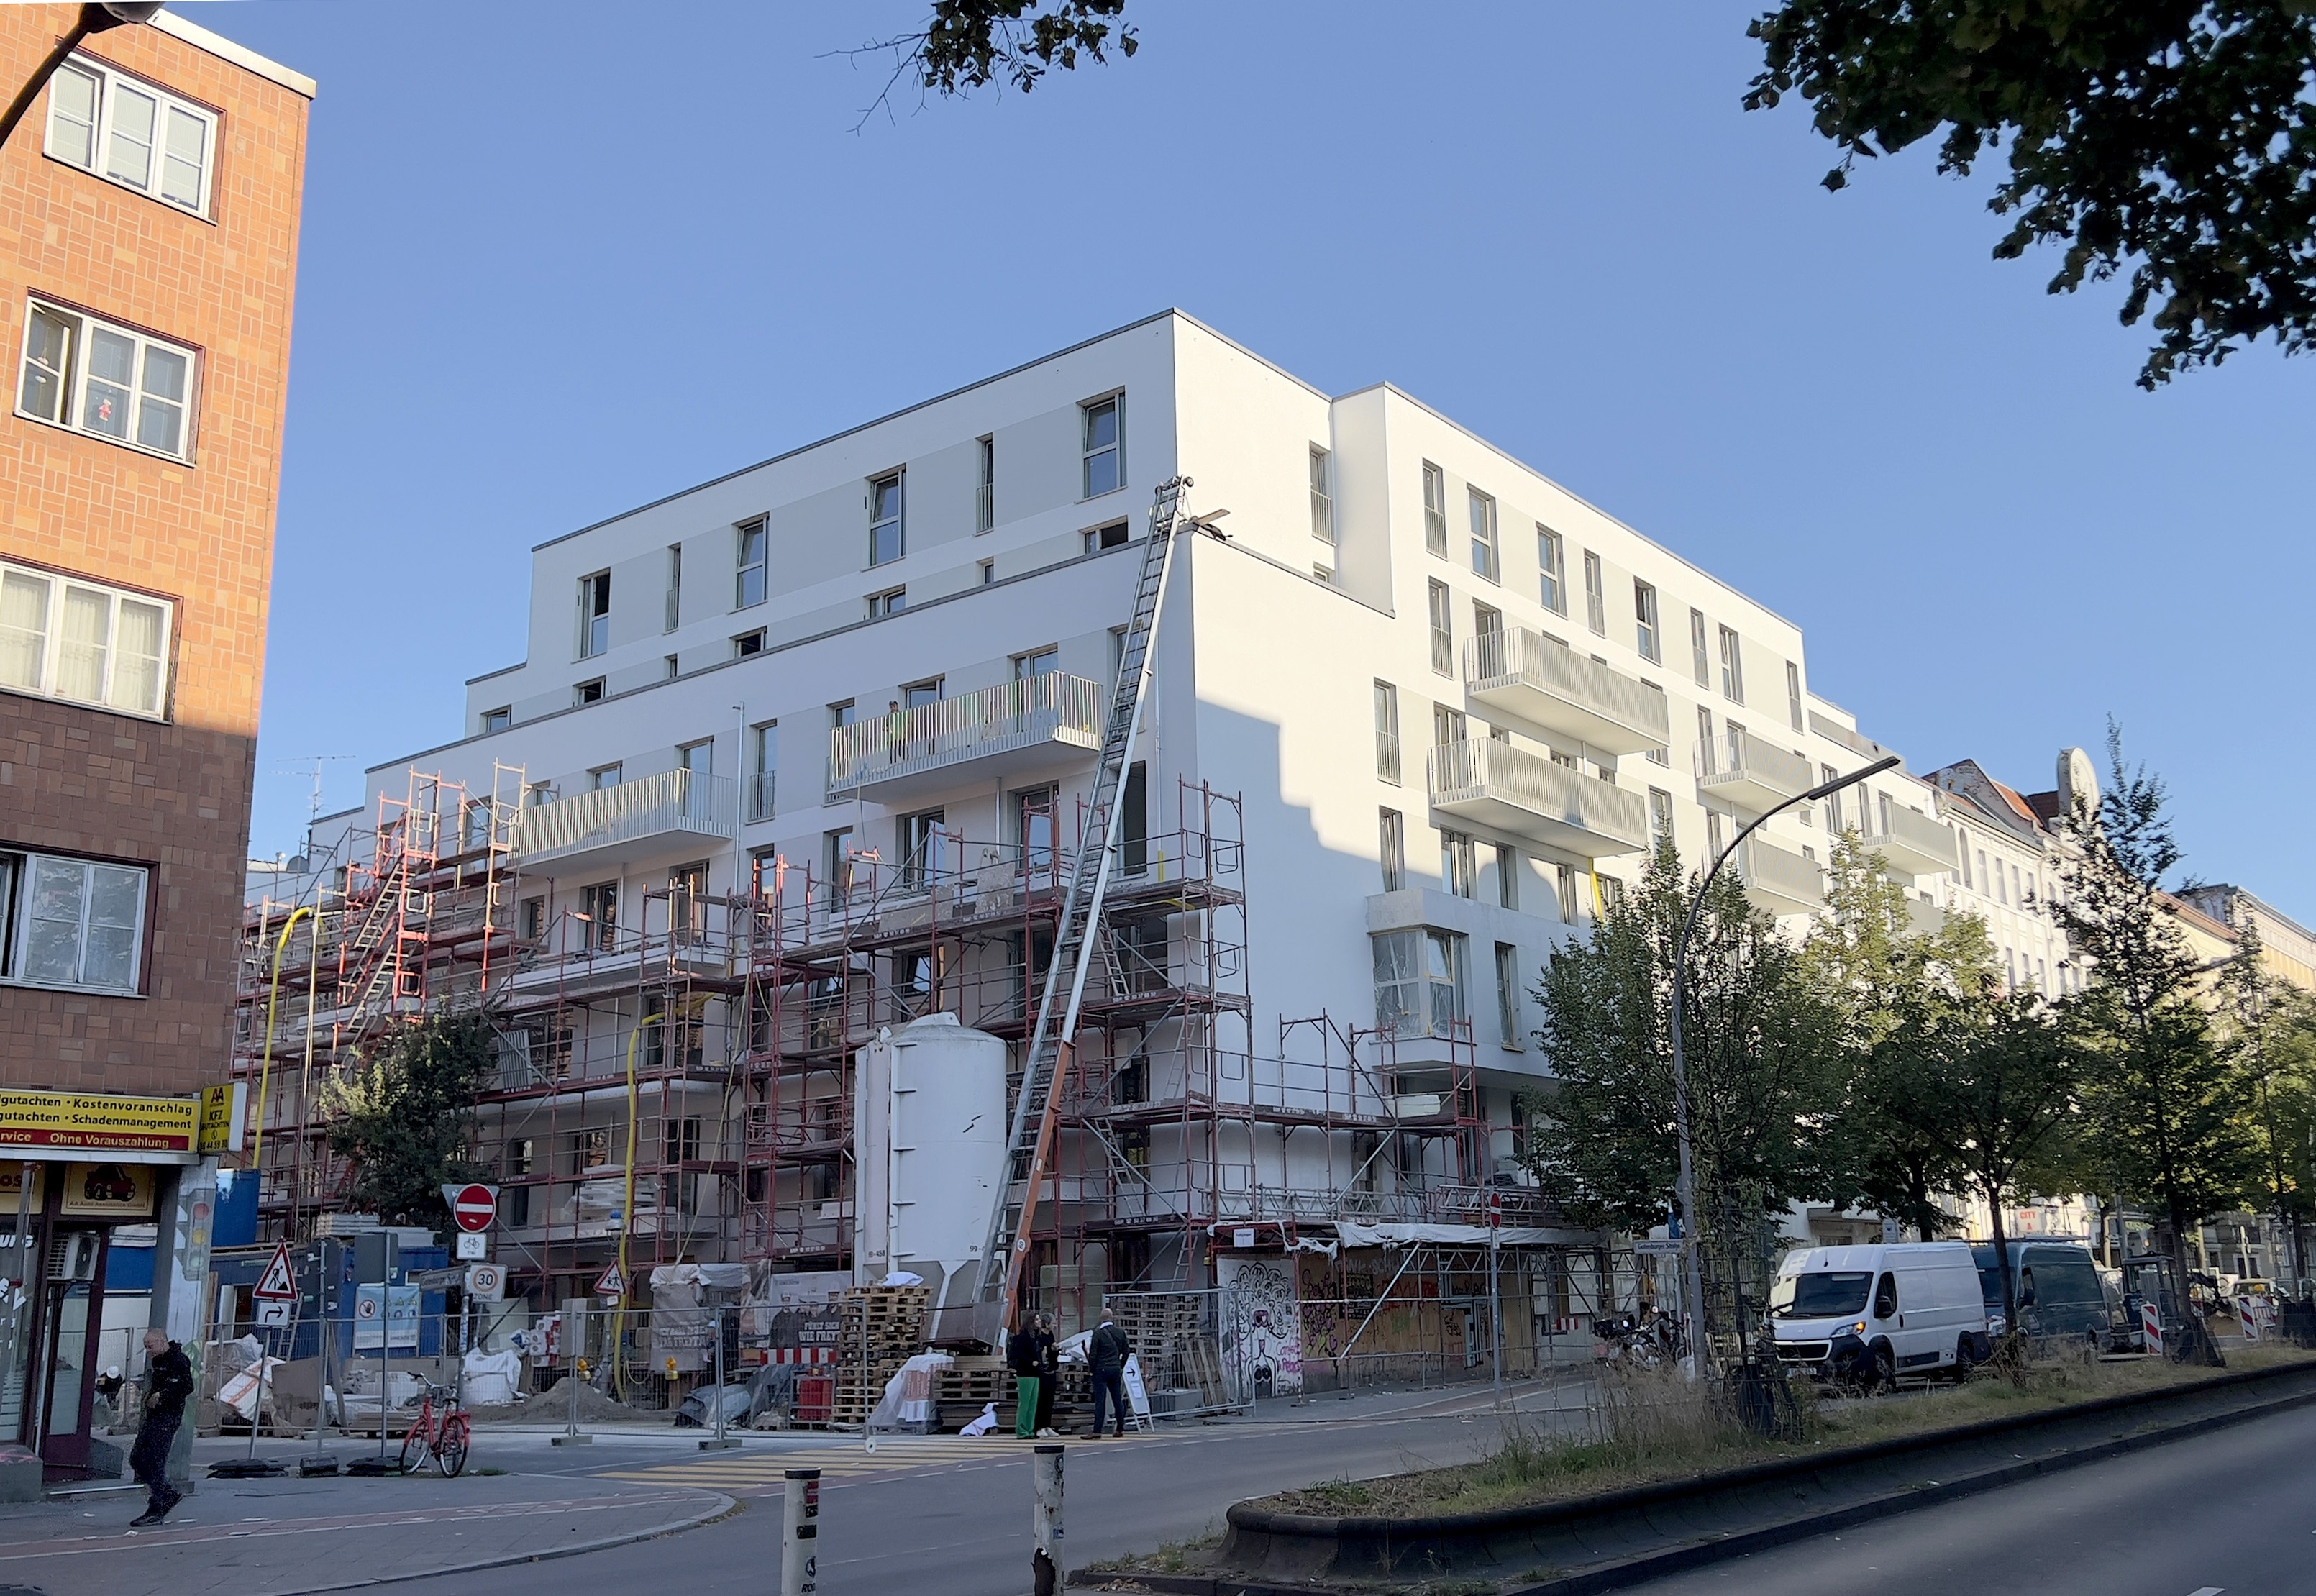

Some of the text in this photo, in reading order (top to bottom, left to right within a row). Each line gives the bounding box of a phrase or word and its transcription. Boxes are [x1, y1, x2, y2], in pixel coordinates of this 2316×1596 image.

[211, 1087, 224, 1103] AA
[73, 1098, 192, 1116] Kostenvoranschlag
[72, 1114, 191, 1130] Schadenmanagement
[209, 1110, 223, 1121] KFZ
[50, 1133, 82, 1144] Ohne
[86, 1134, 169, 1149] Vorauszahlung
[2020, 1210, 2036, 1219] CITY
[478, 1274, 493, 1285] 30
[798, 1331, 815, 1341] WIE
